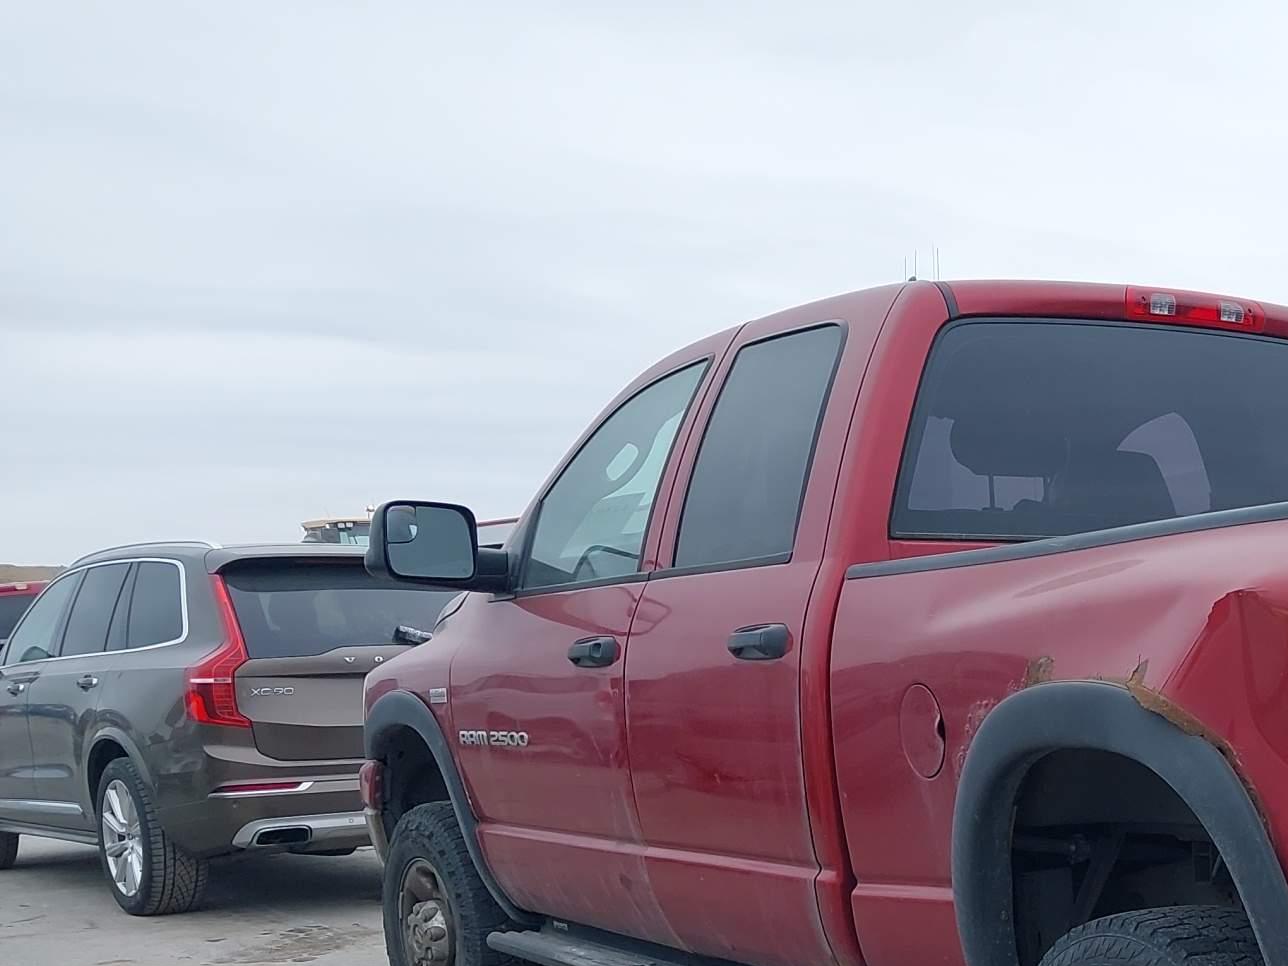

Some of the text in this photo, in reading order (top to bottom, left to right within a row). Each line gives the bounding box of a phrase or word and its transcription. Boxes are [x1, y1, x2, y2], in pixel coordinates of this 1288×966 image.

[250, 687, 295, 697] XC90
[459, 730, 528, 747] RAM 2500
